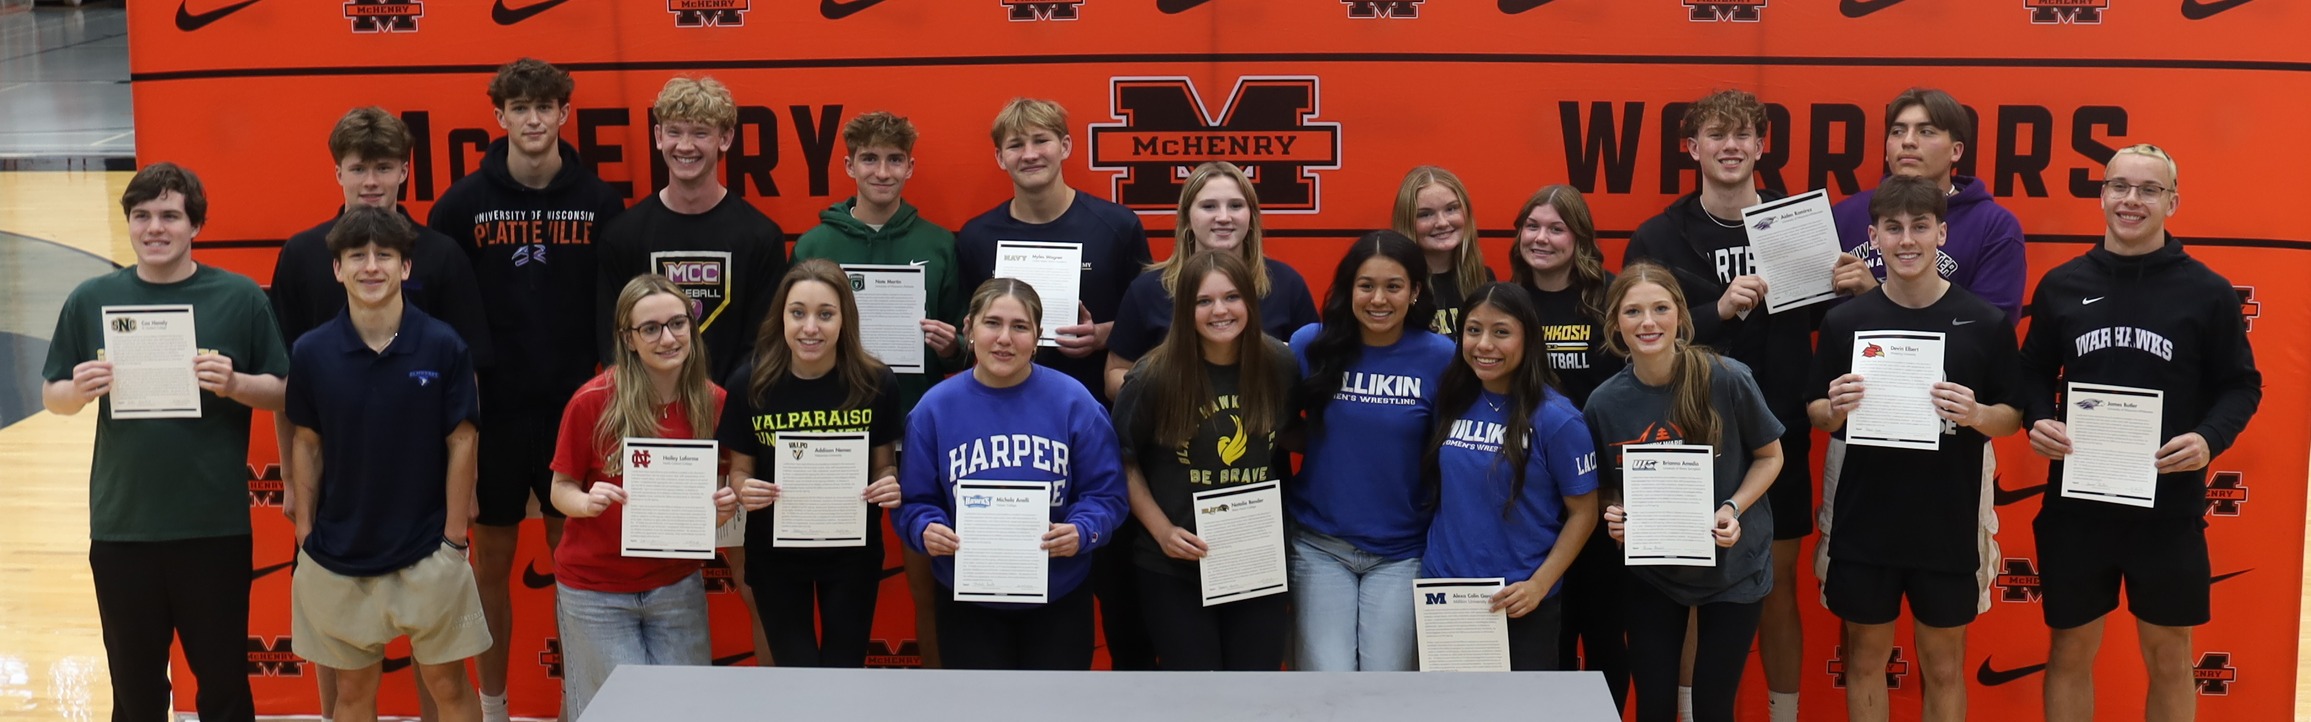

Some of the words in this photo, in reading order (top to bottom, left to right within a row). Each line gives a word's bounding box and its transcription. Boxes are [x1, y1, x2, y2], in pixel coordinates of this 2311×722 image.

[357, 6, 409, 14] McHENRY
[681, 0, 735, 8] McHENRY
[1132, 135, 1297, 156] McHENRY
[474, 220, 593, 248] PLATTEILLE
[666, 263, 720, 283] MCC
[682, 289, 721, 298] EBALL
[111, 317, 136, 332] SNC
[1542, 324, 1591, 341] HKOSH
[1548, 352, 1590, 370] TBALL
[1340, 371, 1421, 398] LLIKIN
[1359, 396, 1416, 405] WRESTLING
[752, 408, 873, 431] VALPARAISO
[788, 441, 808, 450] VALPO
[949, 434, 1070, 483] HARPER
[1190, 468, 1212, 485] BE
[1220, 466, 1268, 484] BRAVE
[1425, 592, 1447, 605] M
